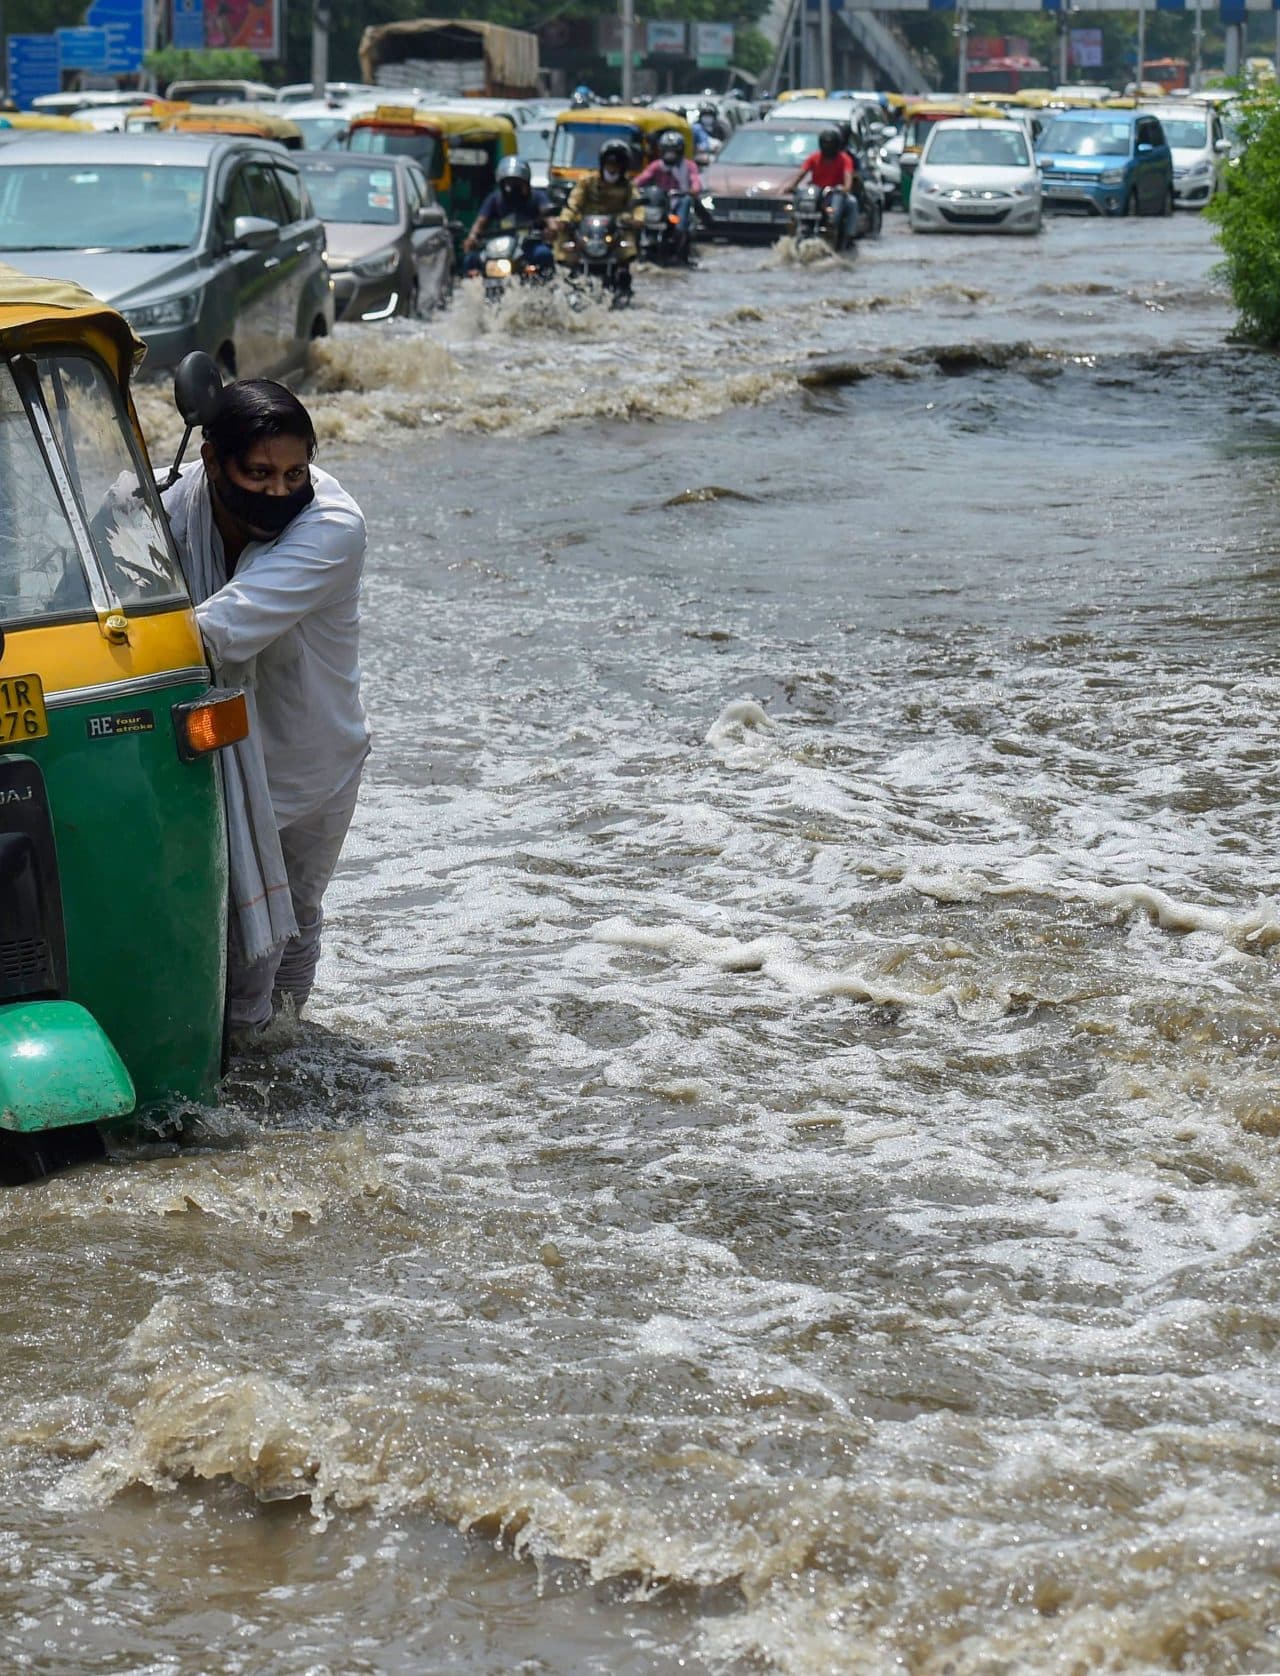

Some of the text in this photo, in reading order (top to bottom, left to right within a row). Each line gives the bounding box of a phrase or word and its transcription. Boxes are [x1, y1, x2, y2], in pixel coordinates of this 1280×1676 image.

[1, 680, 31, 709] 1R
[89, 716, 113, 736] RE
[116, 716, 142, 725] four
[116, 723, 153, 733] stroke
